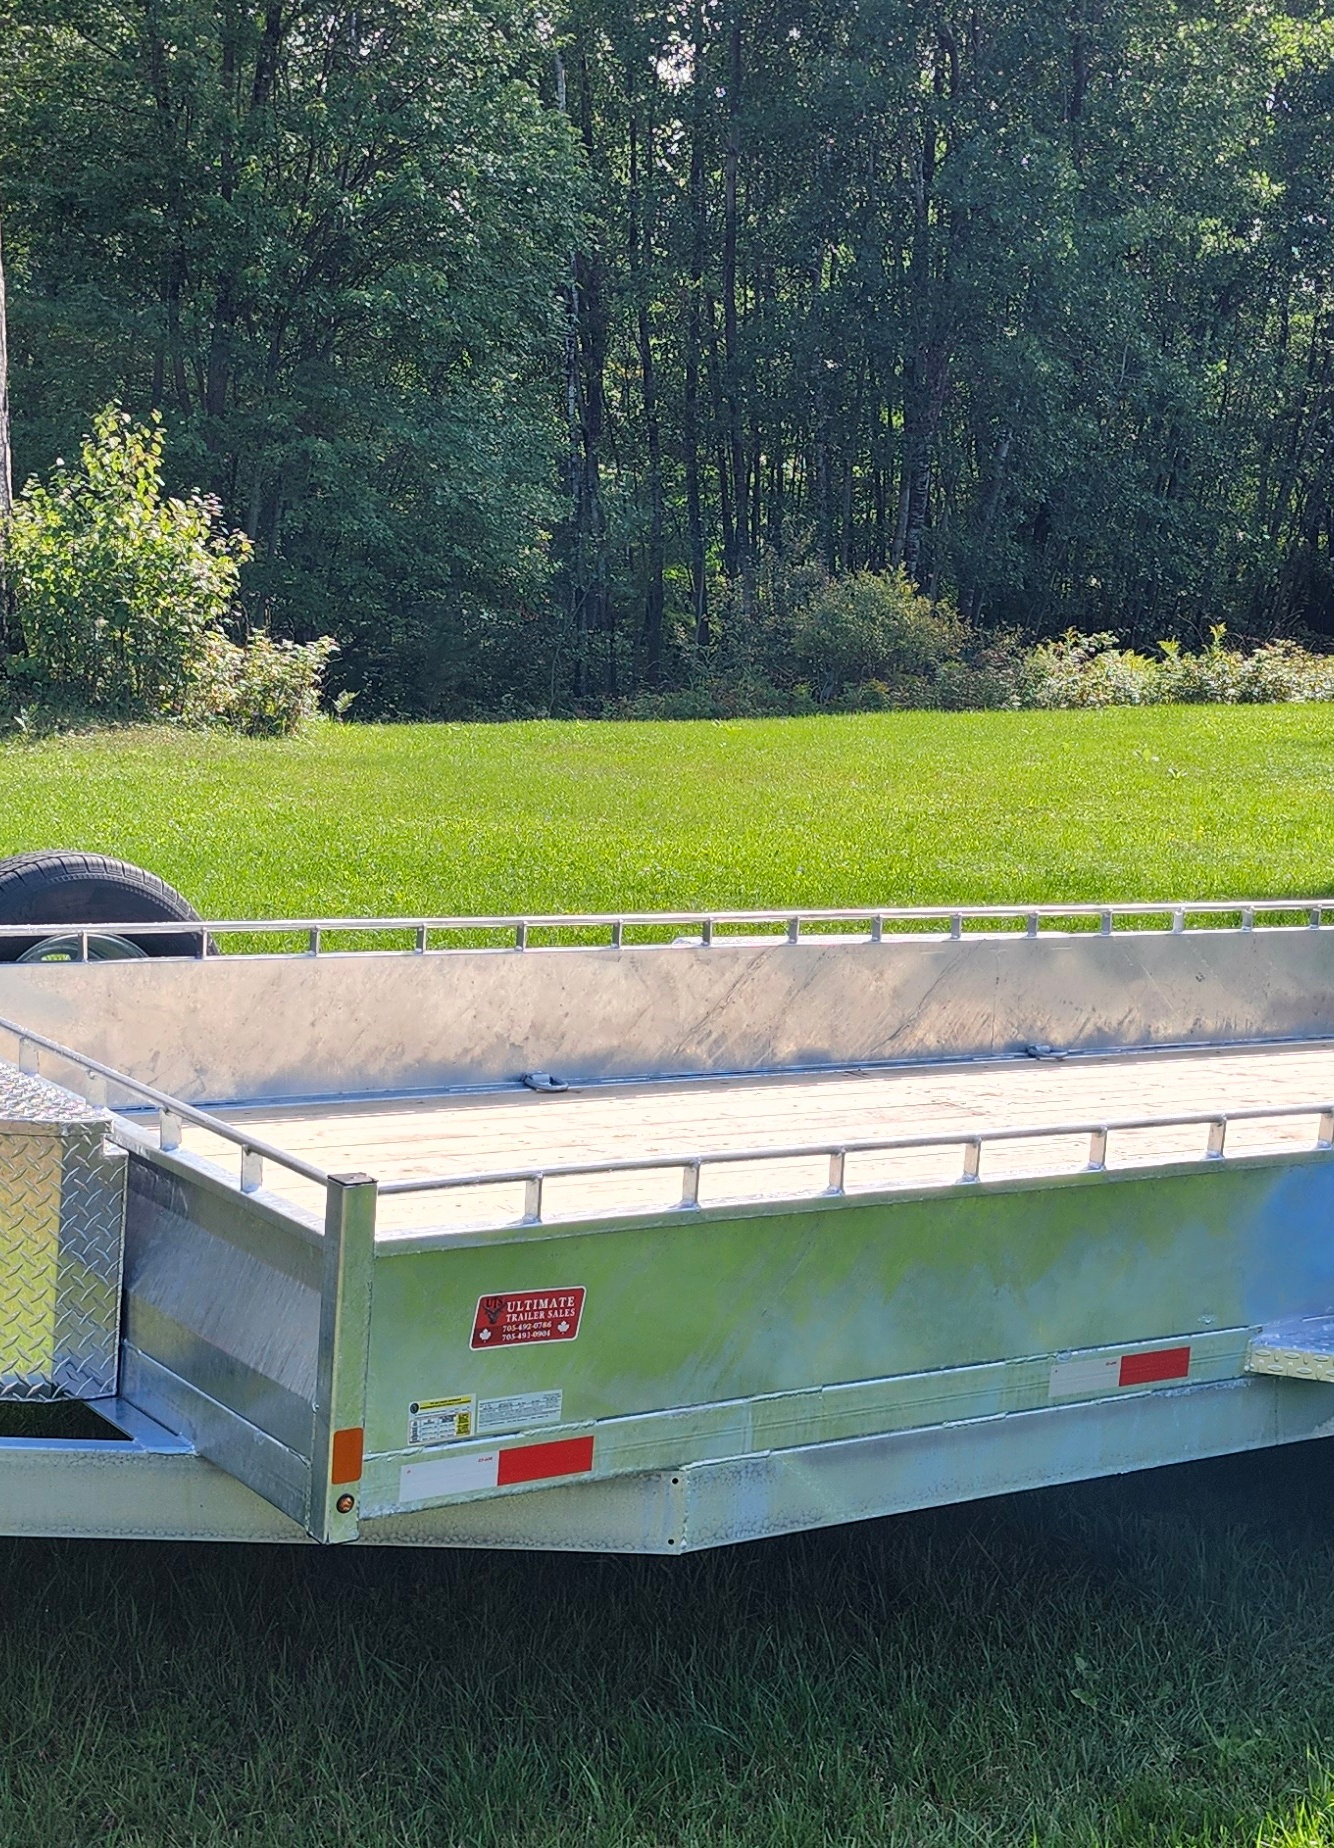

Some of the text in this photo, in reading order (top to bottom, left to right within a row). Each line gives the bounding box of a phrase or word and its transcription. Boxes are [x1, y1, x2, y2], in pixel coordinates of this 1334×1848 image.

[507, 1296, 575, 1312] ULTIMATE
[505, 1308, 575, 1322] TRAILER SALES
